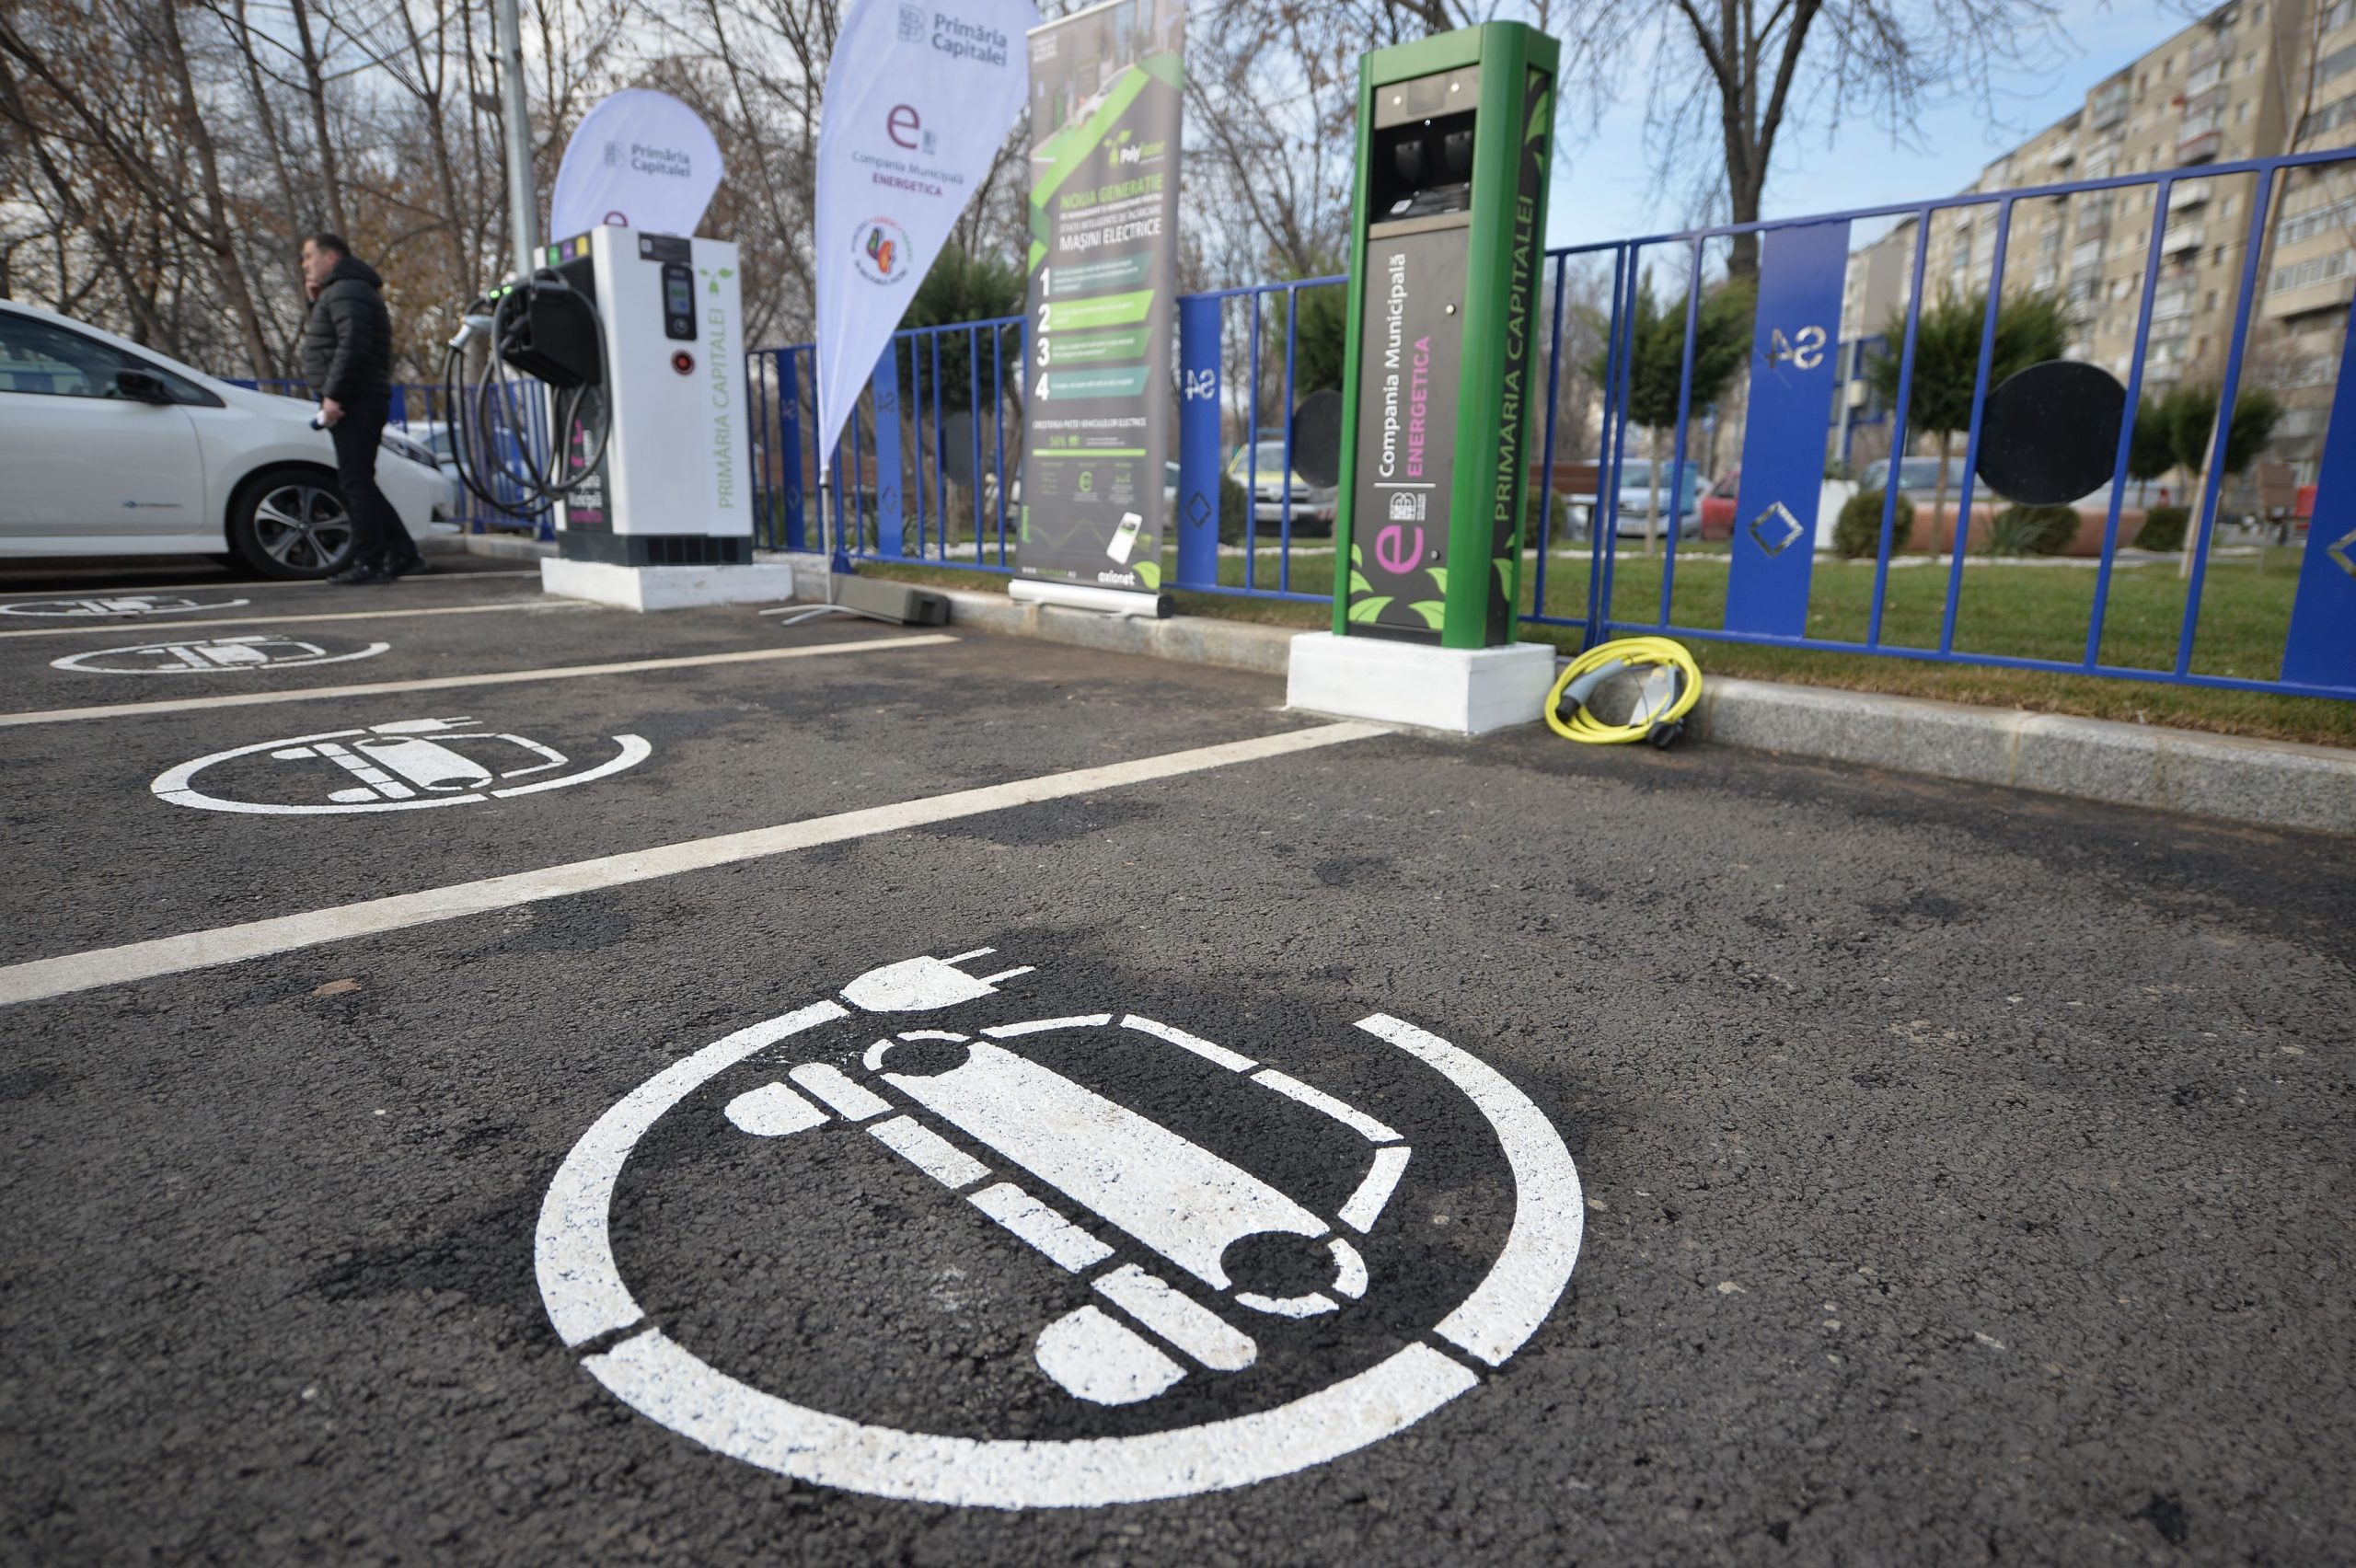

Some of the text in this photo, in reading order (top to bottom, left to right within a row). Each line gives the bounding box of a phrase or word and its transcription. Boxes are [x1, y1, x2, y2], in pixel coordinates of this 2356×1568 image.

[933, 13, 1008, 49] Primăria
[931, 33, 1008, 67] Capitalei
[887, 104, 920, 150] e
[630, 156, 691, 178] Capitalei
[631, 144, 690, 164] Primăria
[872, 172, 942, 197] ENERGETICA
[1039, 266, 1050, 297] 1
[1507, 195, 1533, 362] CAPITALEI
[1037, 303, 1051, 333] 2
[1036, 337, 1051, 367] 3
[1379, 253, 1408, 478] Compania Municipală
[1034, 372, 1050, 402] 4
[708, 307, 734, 509] PRIMĂRIA CAPITALEI
[1407, 336, 1430, 478] ENERGETICA
[1375, 525, 1424, 574] e
